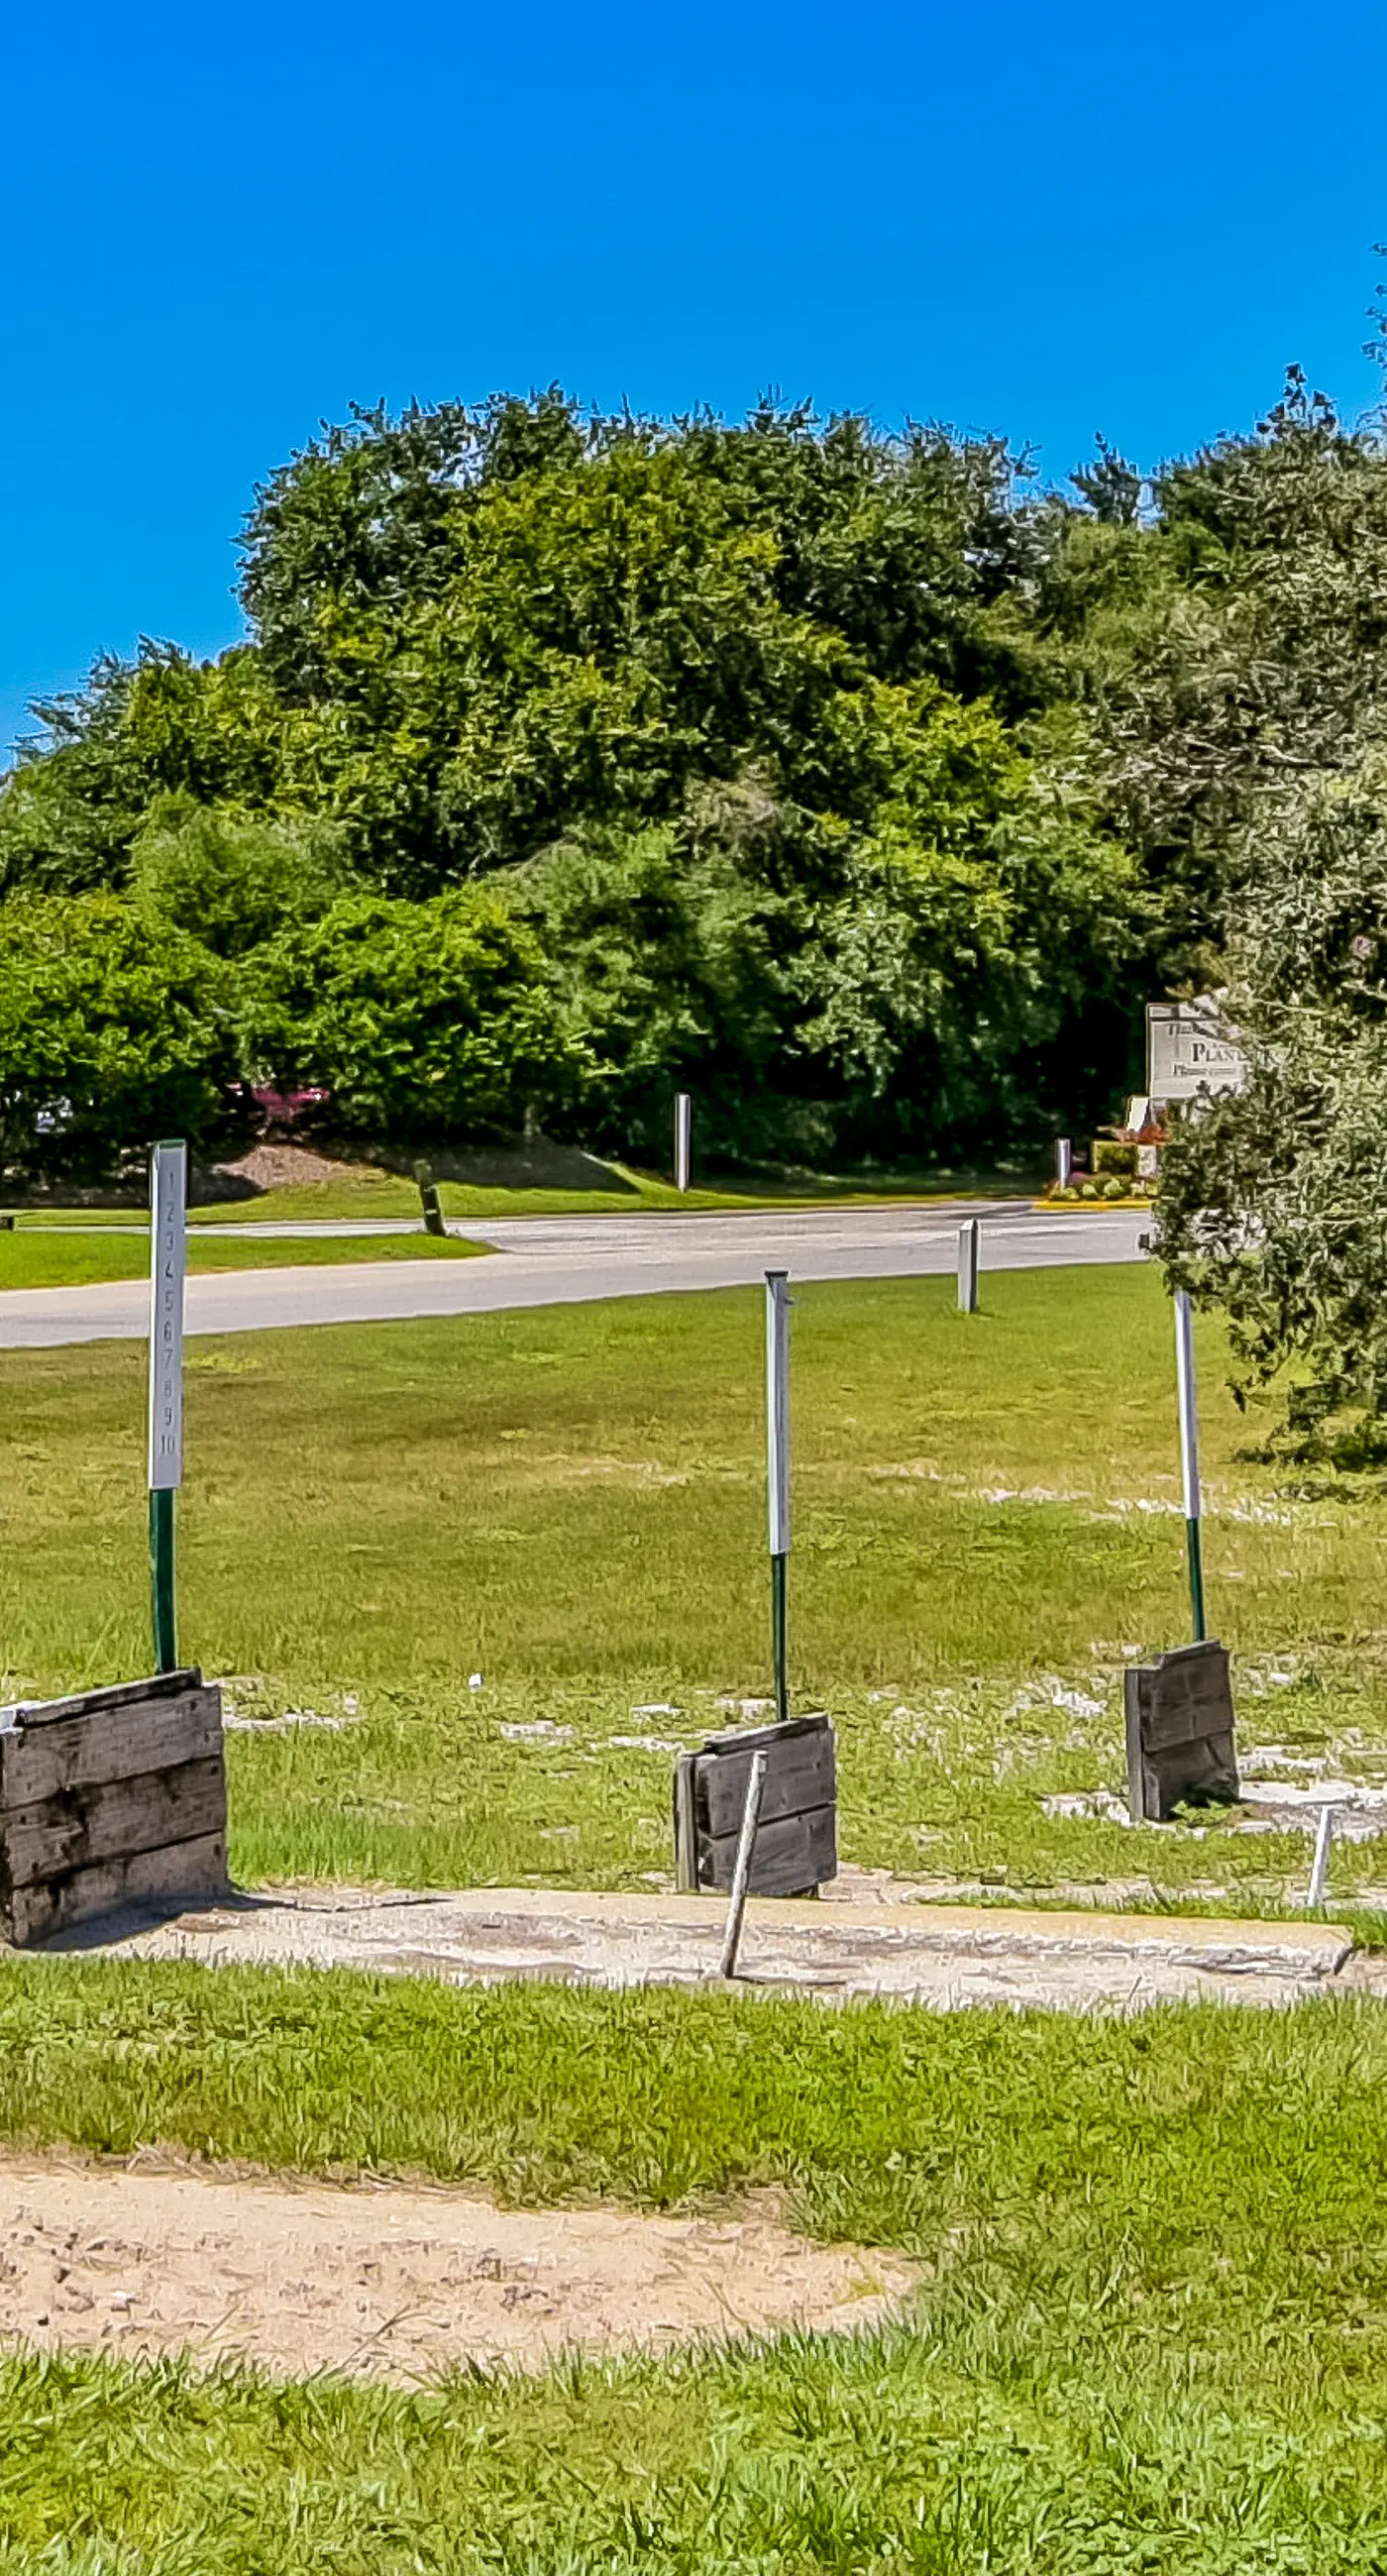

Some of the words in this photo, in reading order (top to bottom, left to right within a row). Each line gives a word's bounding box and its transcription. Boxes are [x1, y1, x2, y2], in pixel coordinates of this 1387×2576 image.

[165, 1200, 174, 1223] 2
[165, 1231, 174, 1251] 3
[163, 1290, 174, 1312] 5
[163, 1321, 172, 1341] 6
[163, 1348, 173, 1368] 7
[163, 1378, 172, 1398] 8
[163, 1407, 172, 1427] 9
[160, 1435, 175, 1455] 10
